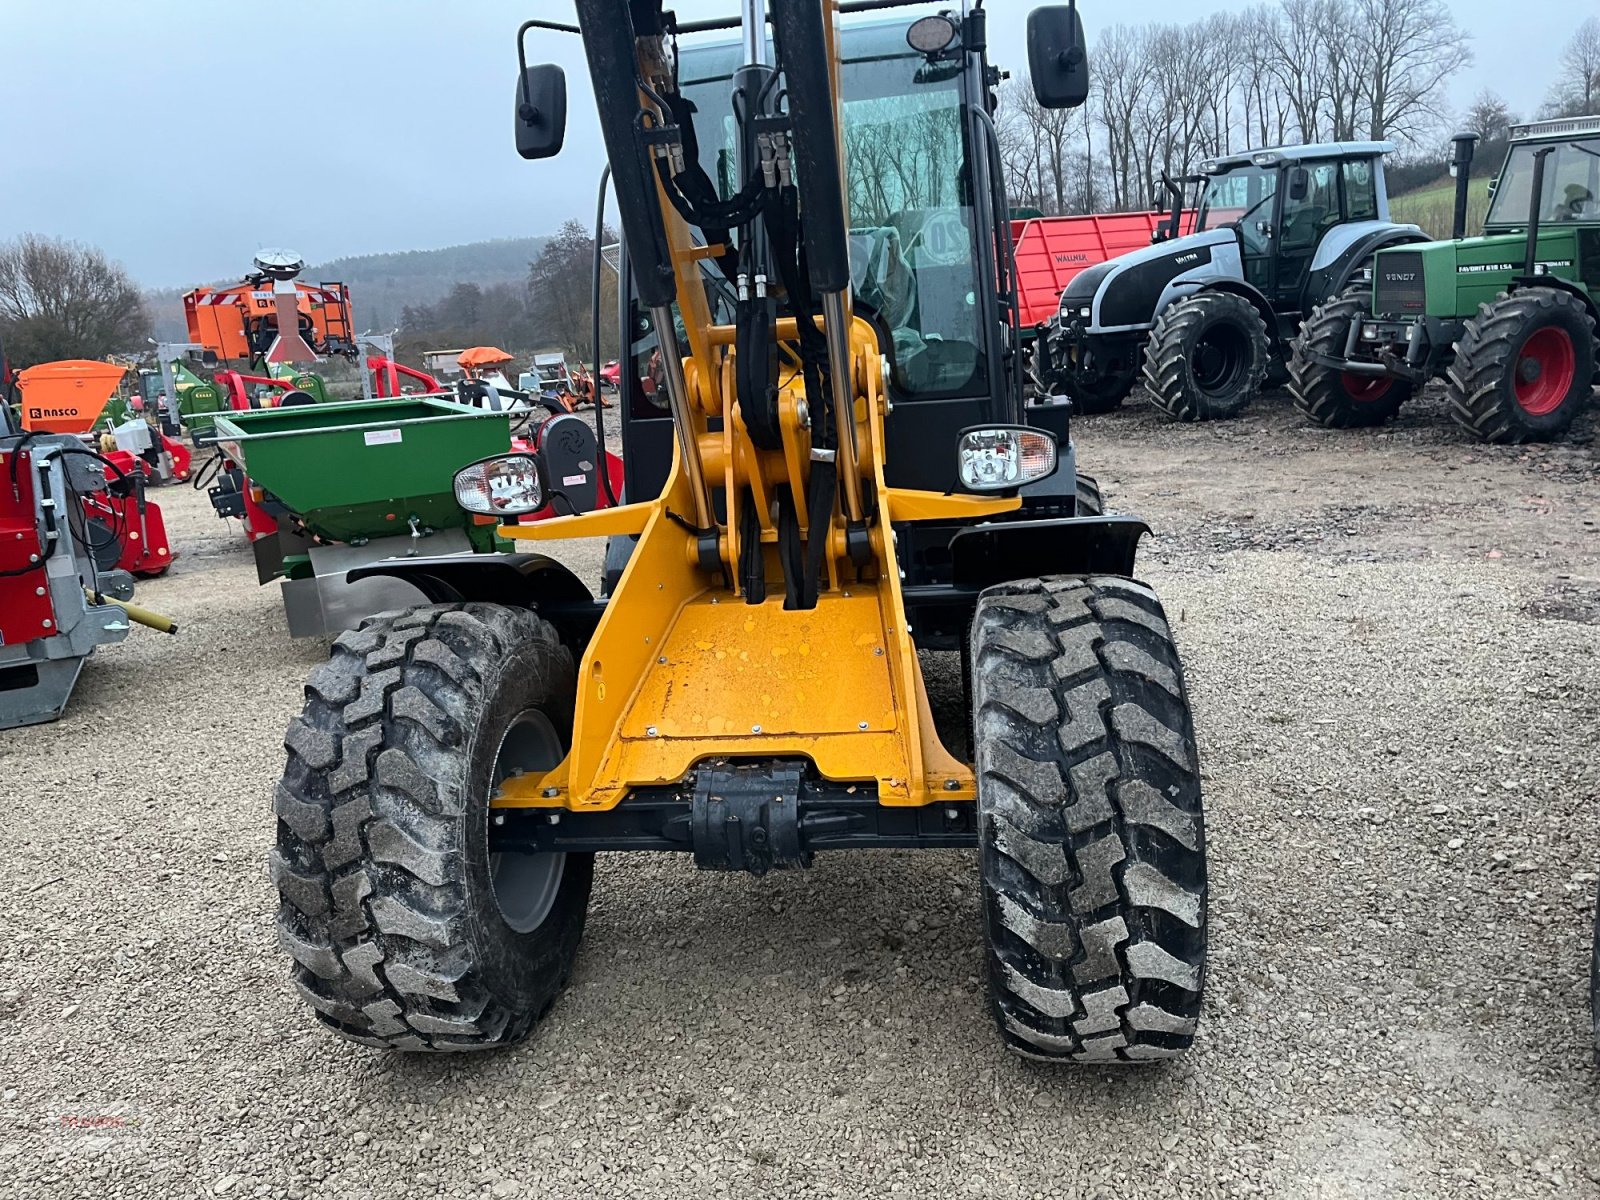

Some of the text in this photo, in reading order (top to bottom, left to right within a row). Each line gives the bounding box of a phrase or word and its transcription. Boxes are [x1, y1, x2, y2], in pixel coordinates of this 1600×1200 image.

[1055, 253, 1088, 263] WALLNER
[1175, 253, 1198, 264] VALTRA
[1458, 265, 1485, 273] FAVORIT
